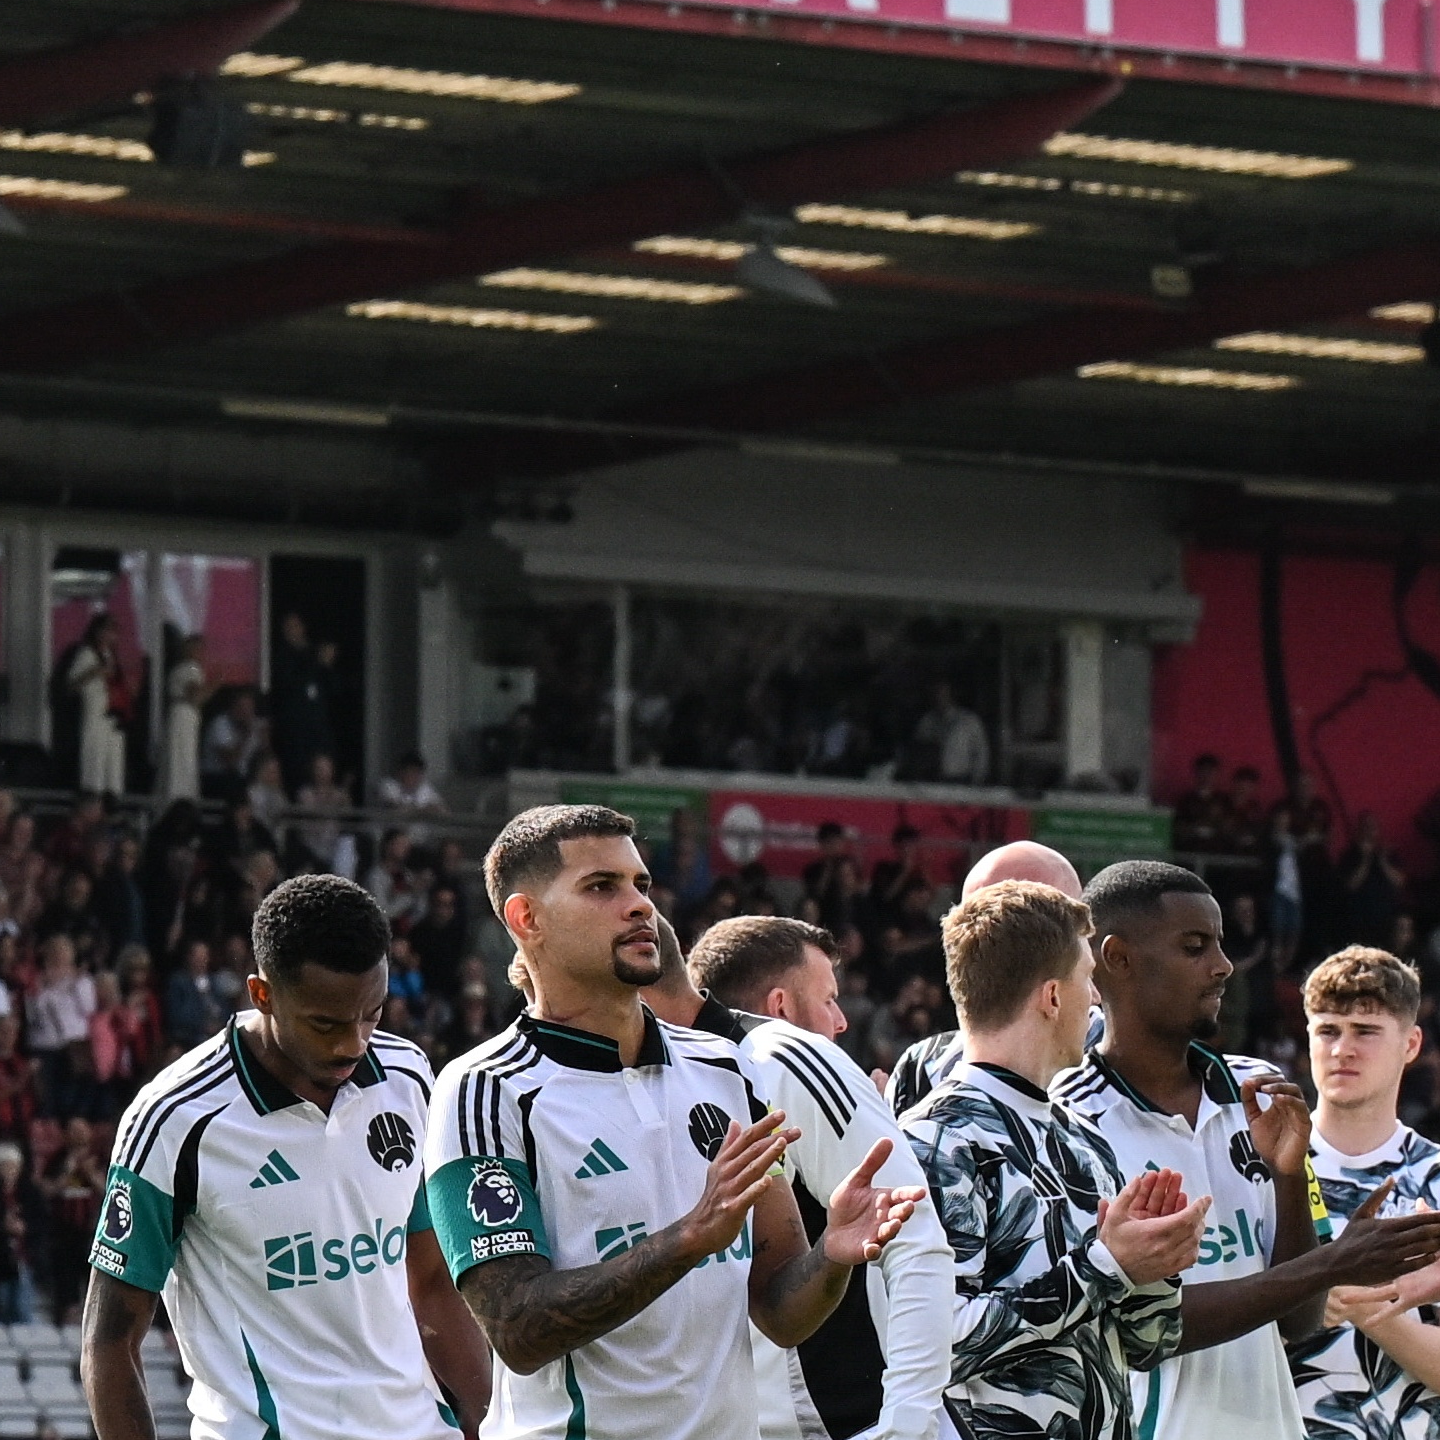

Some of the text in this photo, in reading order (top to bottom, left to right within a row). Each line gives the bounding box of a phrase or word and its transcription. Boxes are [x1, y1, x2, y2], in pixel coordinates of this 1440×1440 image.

[471, 1231, 529, 1248] No room
[472, 1241, 535, 1261] for racism
